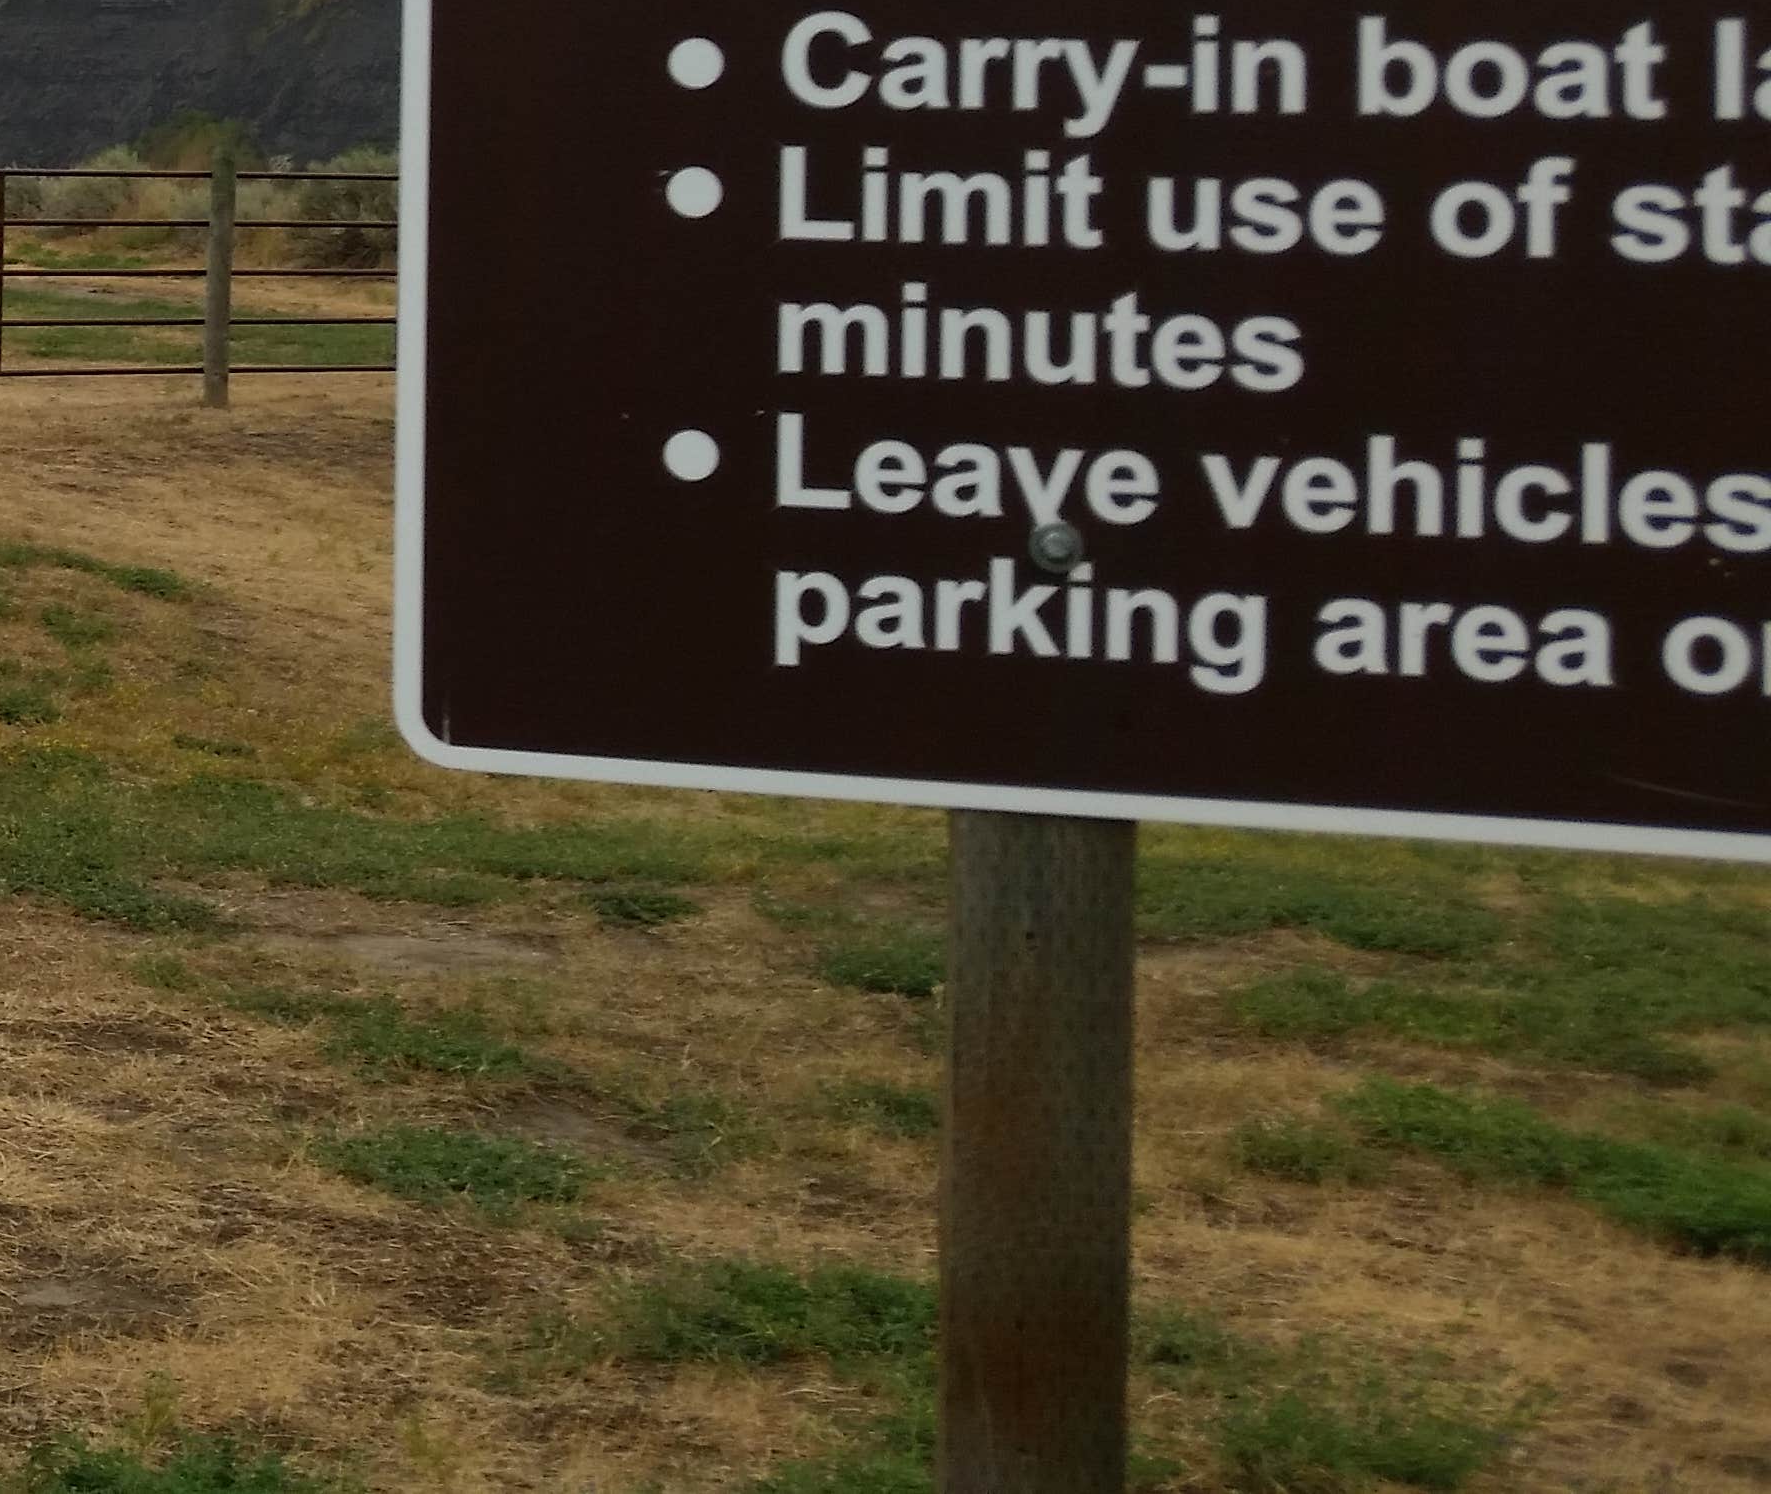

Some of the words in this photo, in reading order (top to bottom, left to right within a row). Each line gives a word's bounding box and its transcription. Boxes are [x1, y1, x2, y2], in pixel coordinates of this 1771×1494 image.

[780, 10, 1307, 139] Carry-in
[1357, 15, 1667, 121] boat
[1715, 17, 1771, 121] l
[779, 144, 1104, 250] Limit
[1147, 176, 1385, 256] use
[1429, 155, 1575, 259] of
[1610, 165, 1771, 266] st
[777, 281, 1305, 393] minutes
[775, 411, 1160, 531] Leave
[1201, 433, 1771, 553] vehicles
[774, 556, 1267, 695] parking
[1313, 597, 1615, 687] area
[1661, 615, 1771, 697] o
